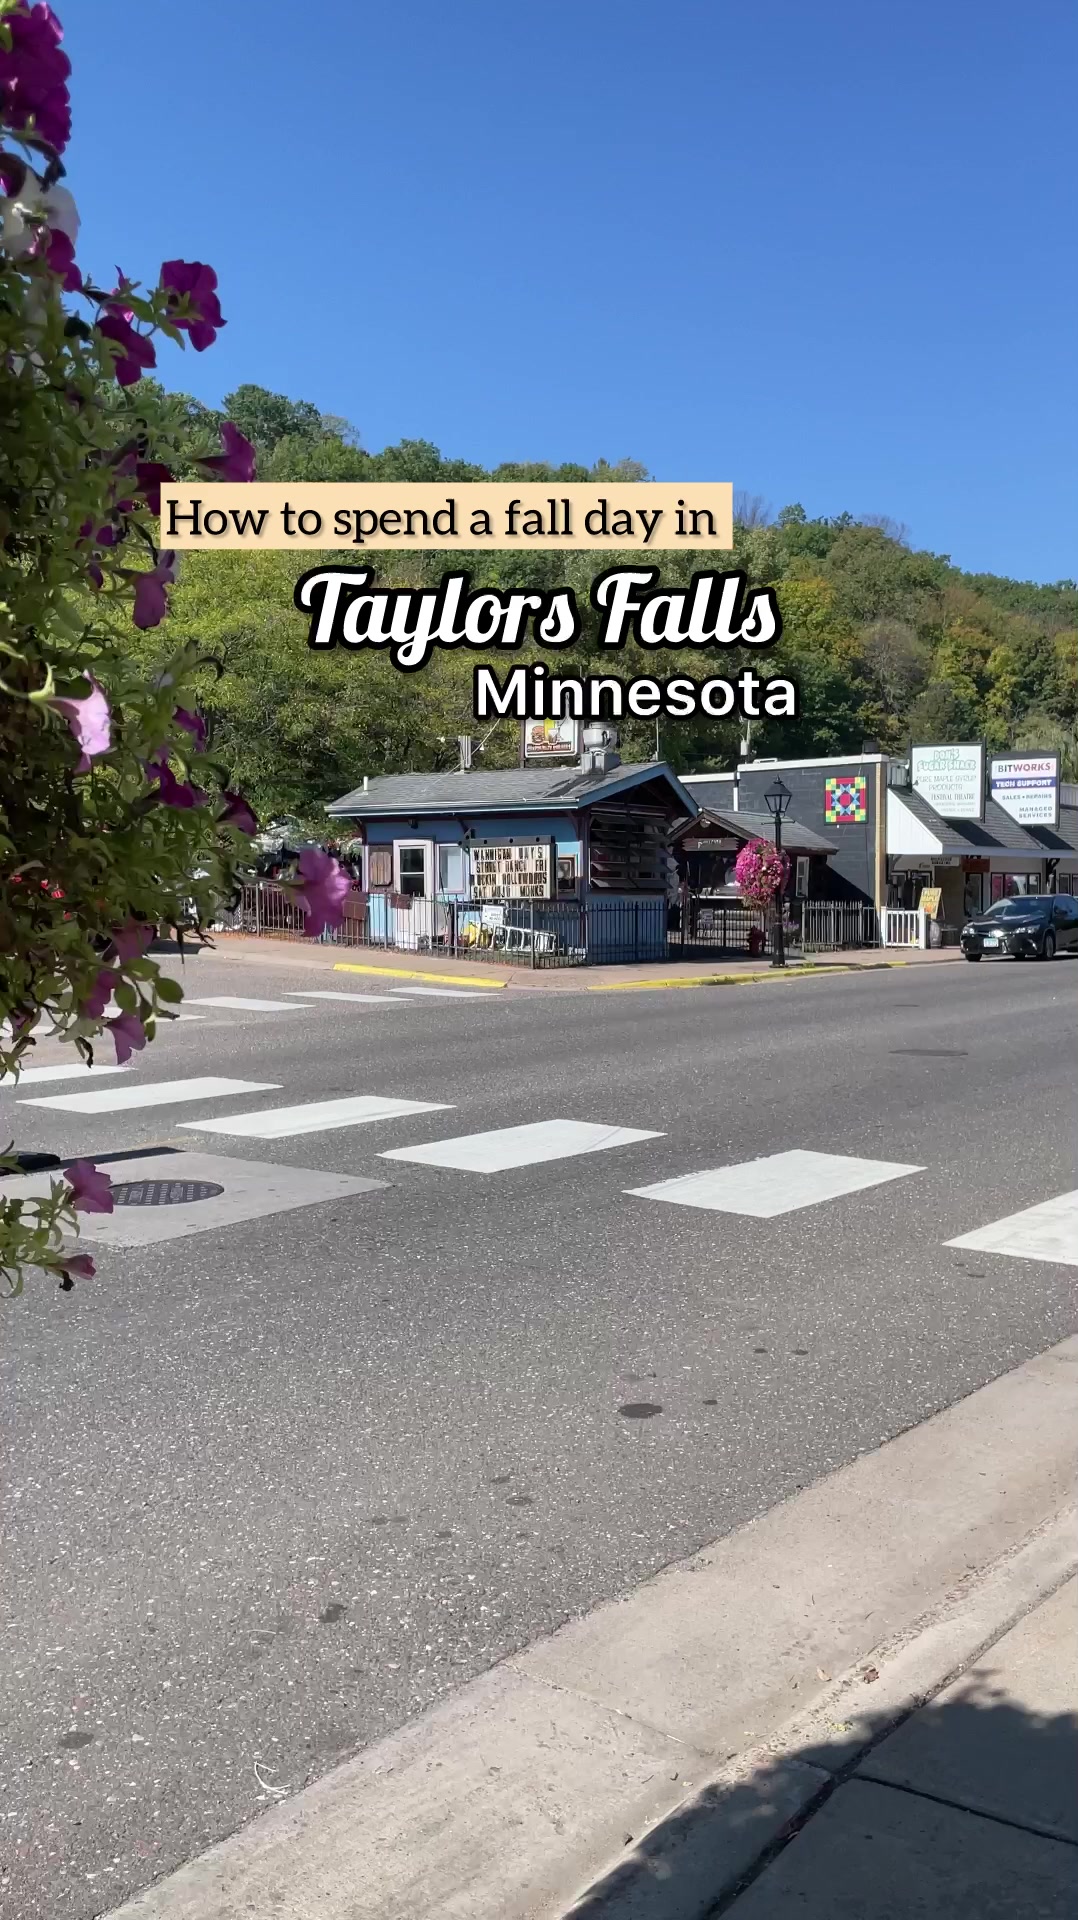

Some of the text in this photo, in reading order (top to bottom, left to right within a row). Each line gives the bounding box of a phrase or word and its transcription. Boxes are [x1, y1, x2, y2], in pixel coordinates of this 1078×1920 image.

[917, 760, 977, 772] SUGAR SHACK
[998, 762, 1051, 773] BITWORKS
[917, 775, 932, 783] PURE
[933, 775, 953, 783] MAPLE
[995, 779, 1053, 788] TECH SUPPORT
[928, 783, 963, 792] PRODUCTS
[473, 846, 543, 861] WANNIGAN DAYS
[476, 860, 501, 873] STREET
[535, 859, 547, 872] FRI
